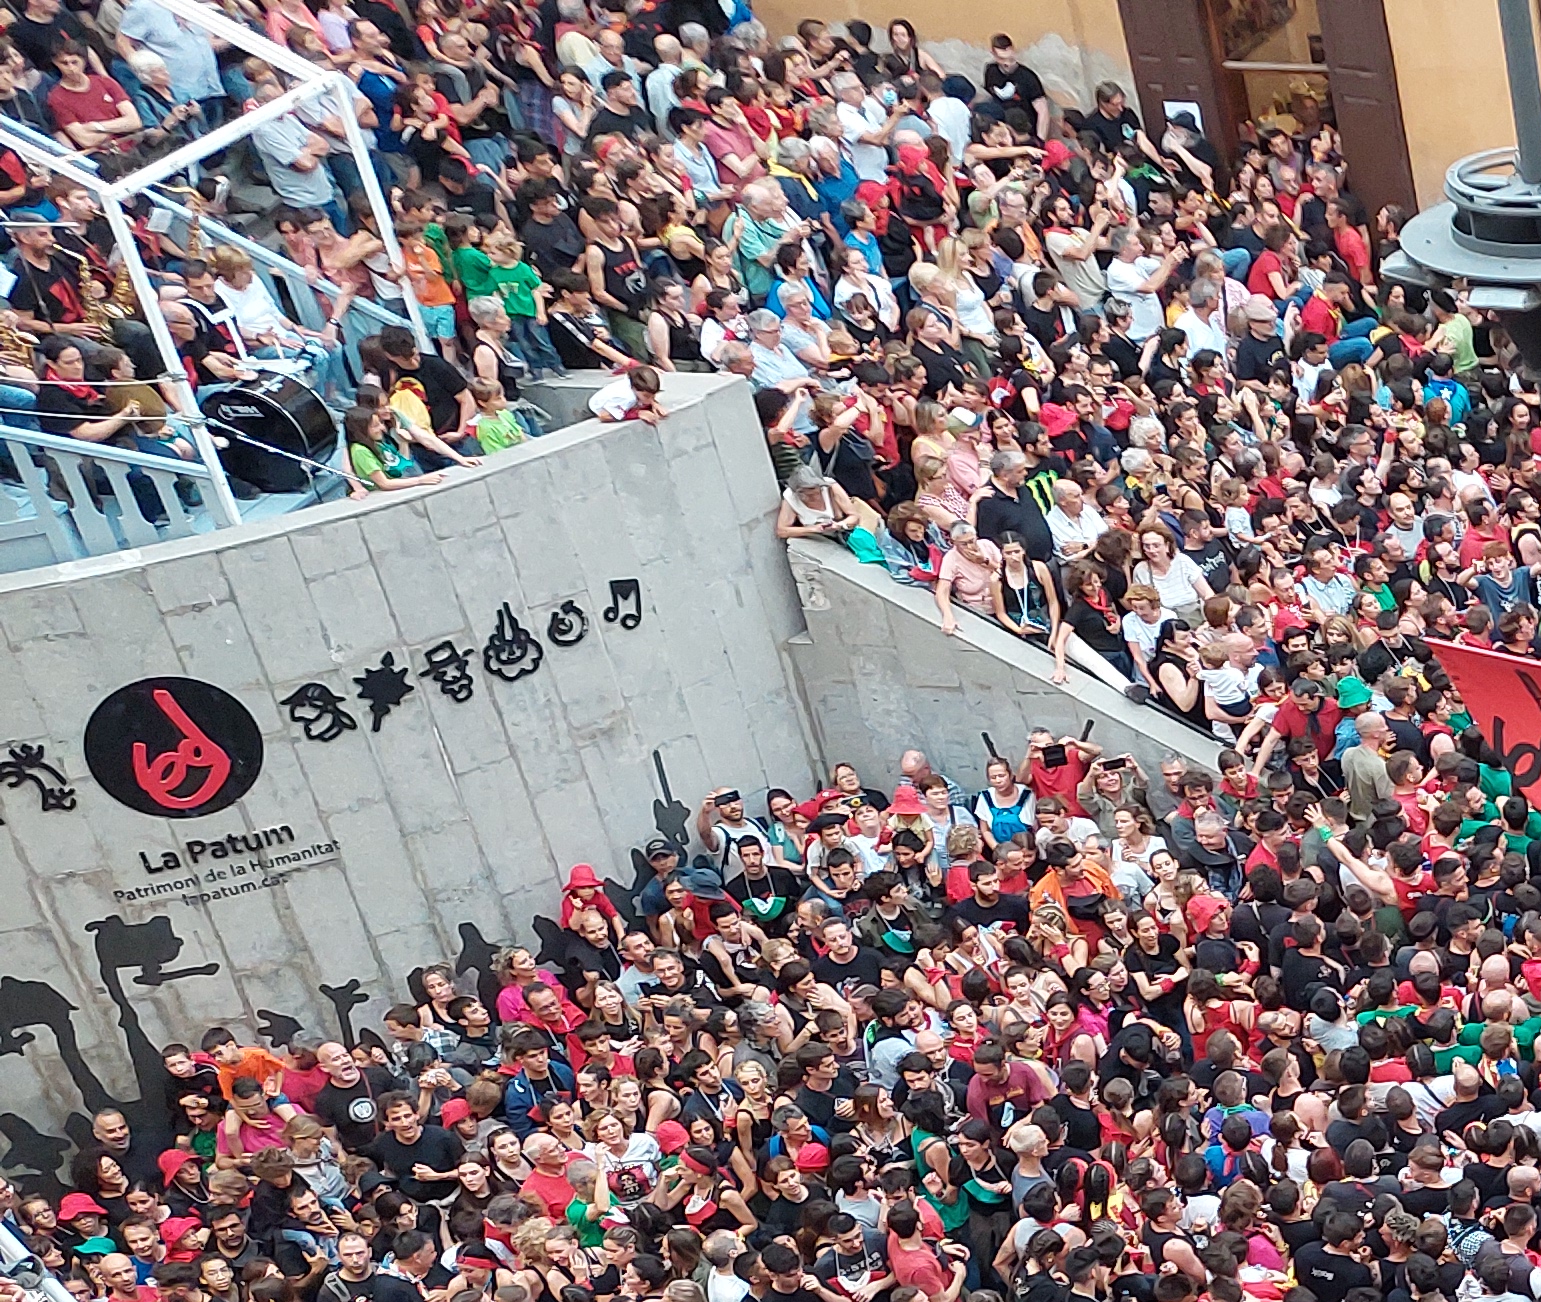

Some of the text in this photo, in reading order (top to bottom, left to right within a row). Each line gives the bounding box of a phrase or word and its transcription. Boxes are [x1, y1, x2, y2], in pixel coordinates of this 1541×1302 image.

[113, 839, 341, 903] Patrimoni de la Humanitat
[138, 823, 295, 875] La Patum
